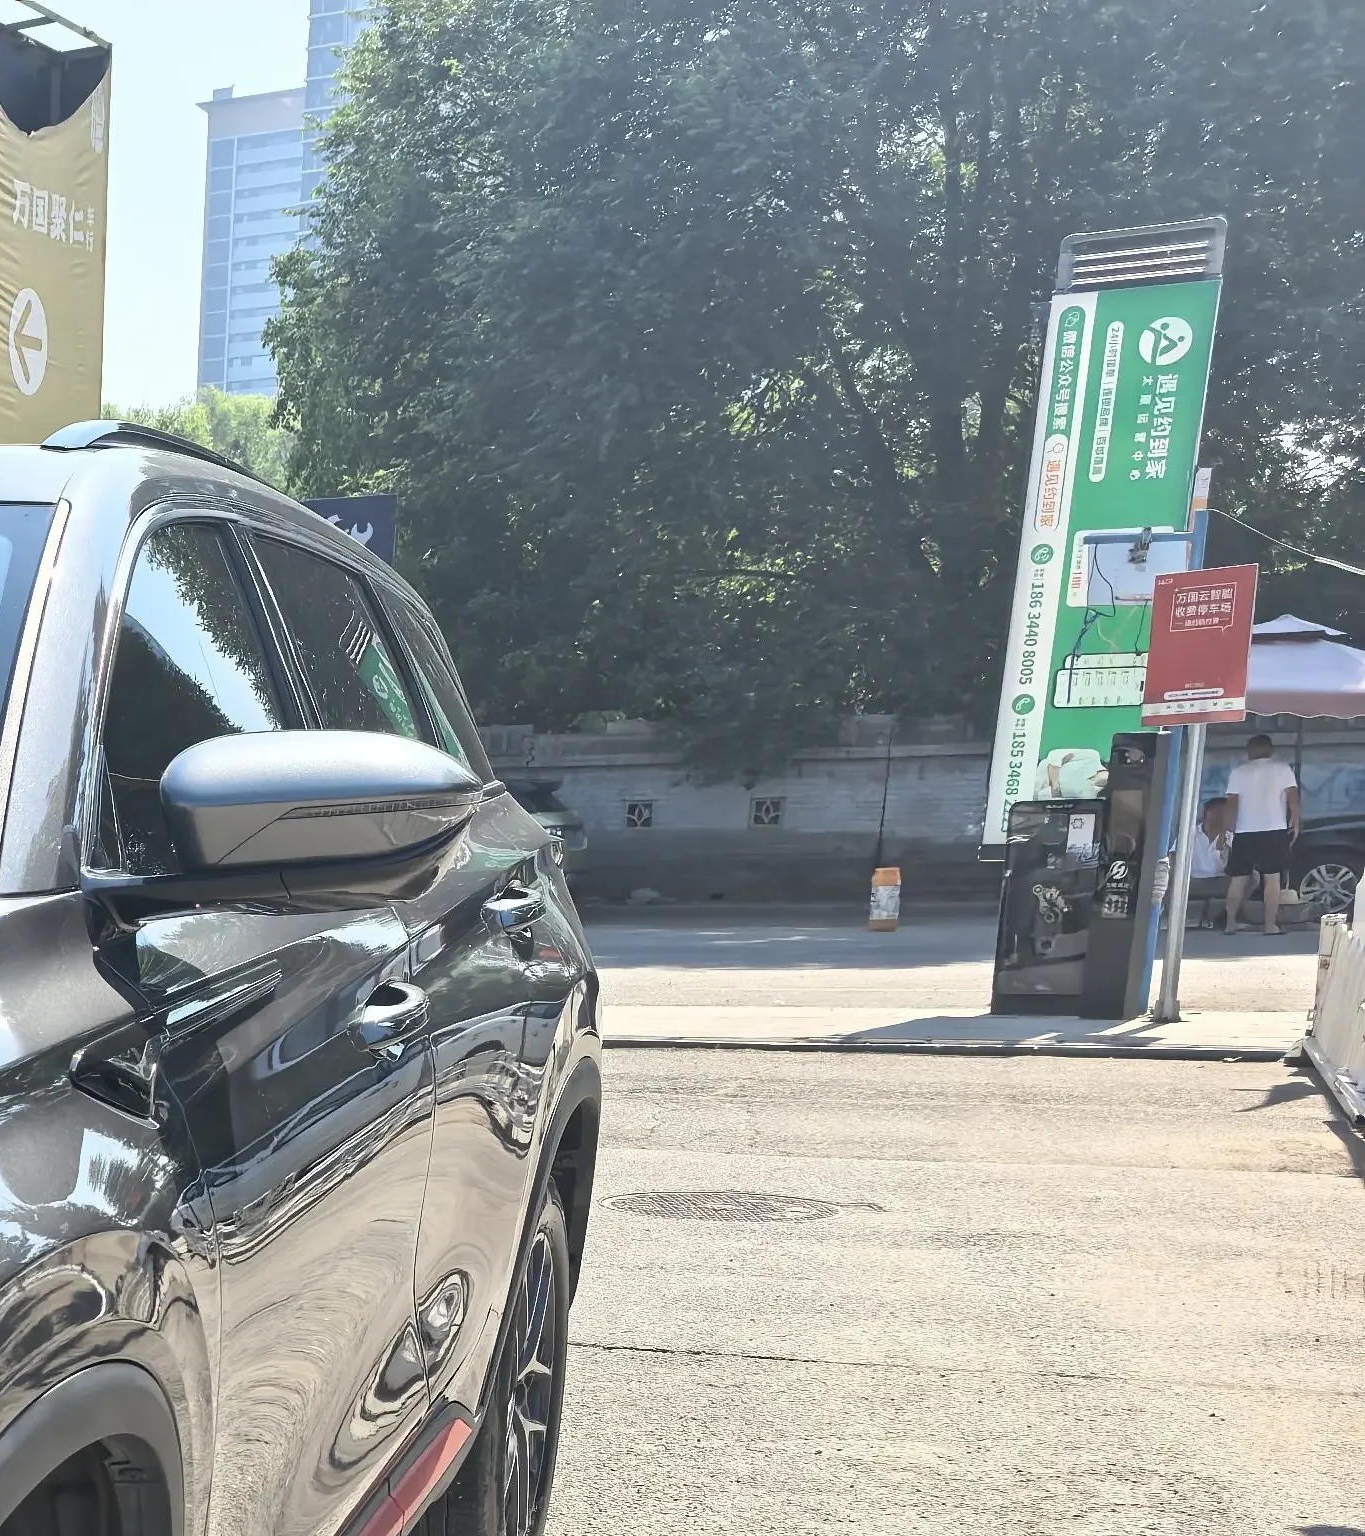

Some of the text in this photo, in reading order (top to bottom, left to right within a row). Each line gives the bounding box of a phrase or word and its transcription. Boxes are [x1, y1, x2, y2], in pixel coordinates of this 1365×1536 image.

[12, 179, 95, 252] 万国聚仁 车行
[1040, 330, 1077, 527] 微信公众号搜索 遇见约到家
[1129, 375, 1155, 481] 太原运营中心
[1144, 373, 1179, 480] 遇见约到家
[1029, 582, 1045, 608] 186
[1175, 588, 1233, 604] 万国云智能
[1175, 602, 1232, 617] 收费停车场
[1024, 610, 1042, 648] 3440
[1019, 650, 1037, 686] 8005
[1011, 732, 1026, 758] 185
[1006, 760, 1023, 796] 3468
